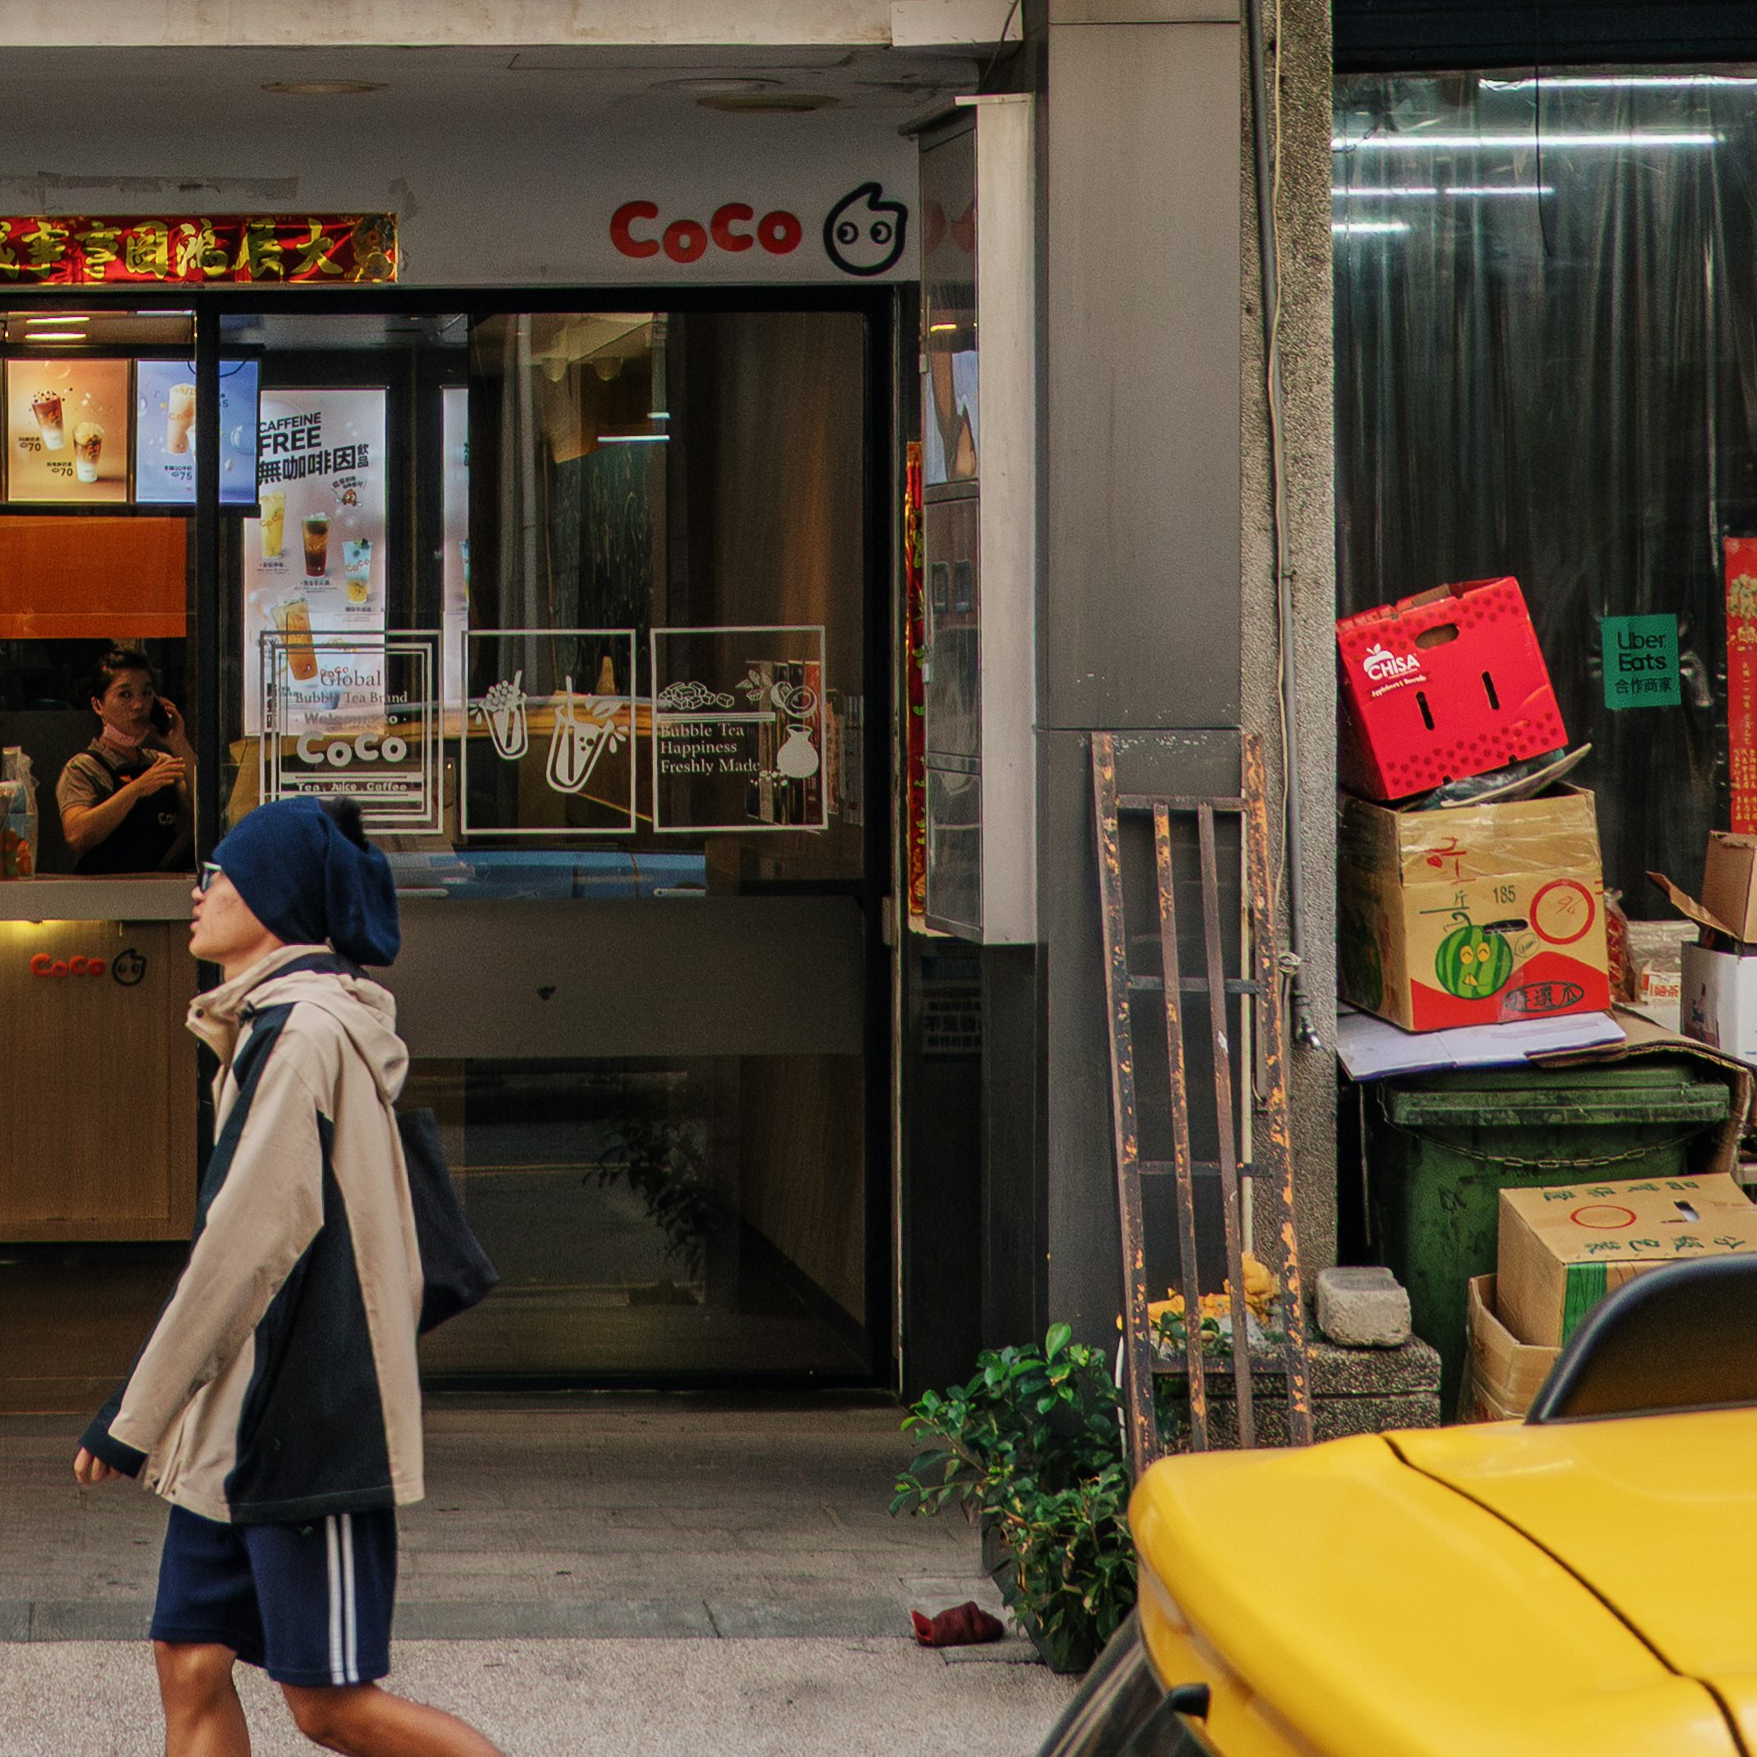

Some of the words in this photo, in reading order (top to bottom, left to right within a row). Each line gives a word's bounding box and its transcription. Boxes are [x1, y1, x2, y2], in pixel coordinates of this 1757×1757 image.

[610, 200, 802, 264] CoCo
[260, 412, 322, 433] CAFFEINE
[28, 443, 42, 452] 70
[260, 425, 322, 457] FREE
[59, 468, 74, 477] 70
[259, 445, 356, 486] 無咖啡因
[357, 443, 370, 469] 飲品
[179, 472, 193, 481] 75
[1617, 631, 1666, 650] Uber
[1367, 653, 1421, 681] CHISA
[1618, 653, 1667, 672] Eats
[320, 670, 382, 687] Global
[1614, 676, 1673, 695] 合作商家
[295, 691, 341, 704] Bubbl
[345, 691, 366, 704] Tea
[369, 690, 408, 704] Brand
[660, 722, 713, 738] Bubble
[717, 722, 745, 737] Tea
[296, 729, 408, 768] CoCo
[660, 740, 738, 758] Happiness
[660, 758, 714, 776] Freshly
[718, 758, 761, 773] Made
[366, 781, 408, 792] Coffee
[1493, 884, 1517, 905] 185
[30, 952, 107, 978] CoCo
